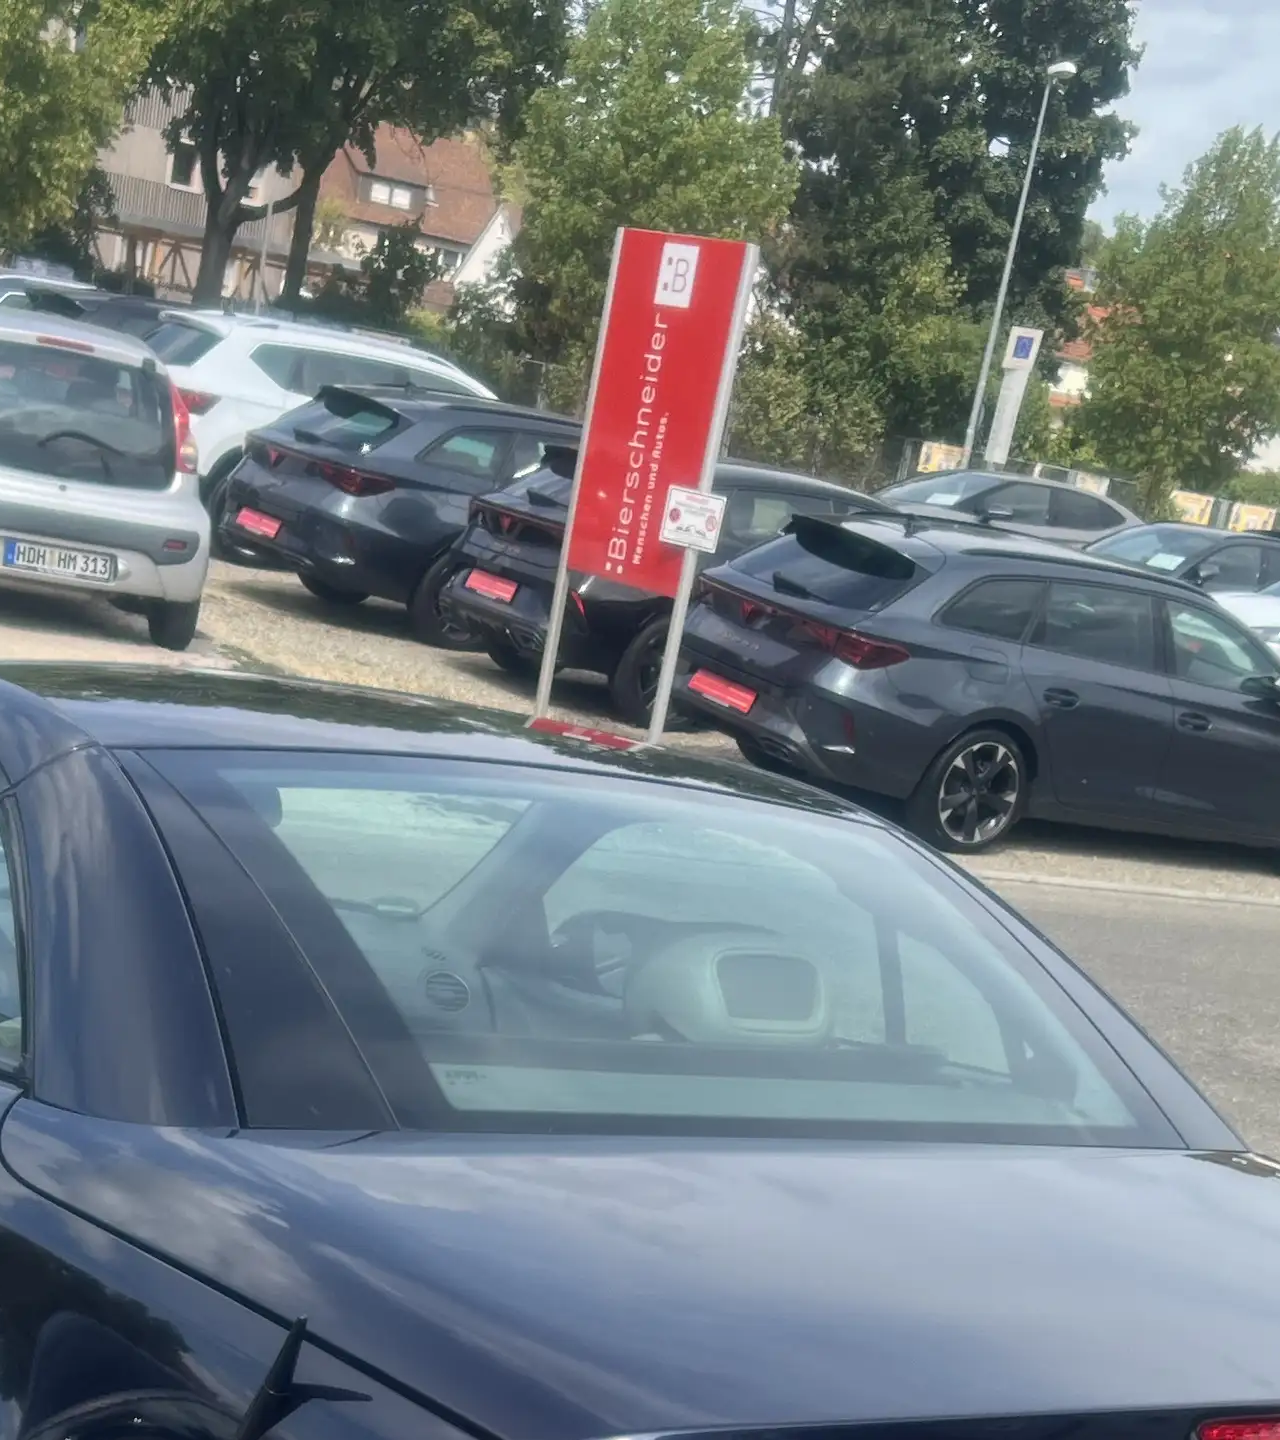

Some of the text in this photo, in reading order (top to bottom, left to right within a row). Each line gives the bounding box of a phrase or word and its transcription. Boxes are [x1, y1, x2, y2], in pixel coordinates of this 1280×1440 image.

[632, 494, 653, 565] Menschen
[647, 463, 659, 491] und
[15, 545, 47, 566] HDH
[57, 551, 78, 571] HM
[80, 554, 109, 576] 313
